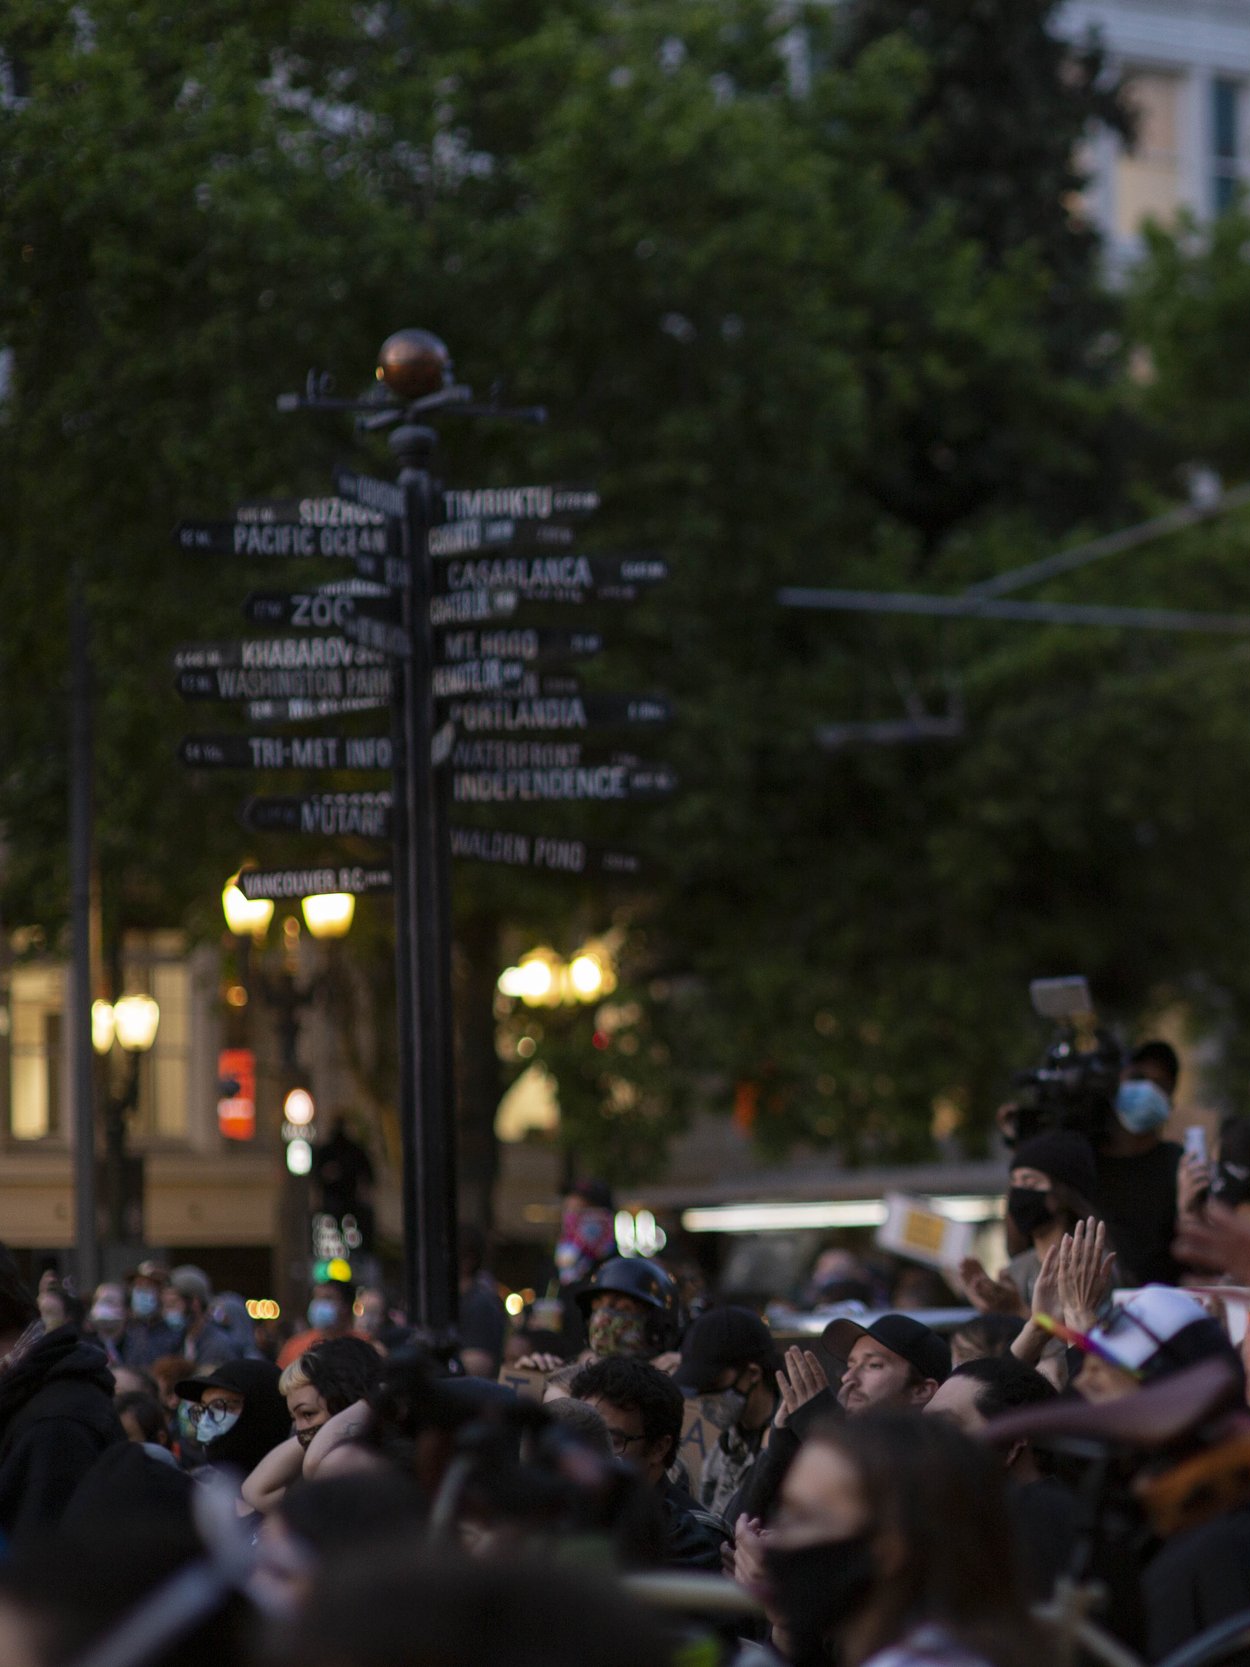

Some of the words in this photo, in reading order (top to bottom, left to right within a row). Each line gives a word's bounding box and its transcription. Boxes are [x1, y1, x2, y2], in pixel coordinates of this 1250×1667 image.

[233, 526, 316, 555] PACIFIC
[319, 526, 386, 555] OCEAN
[447, 557, 593, 590] CASABLANCA
[479, 629, 539, 661] HOOD
[217, 669, 342, 699] WASHINGTON
[248, 738, 339, 769] TRI-MET
[345, 738, 392, 769] INFO
[453, 766, 629, 802] INDEPENDENCE
